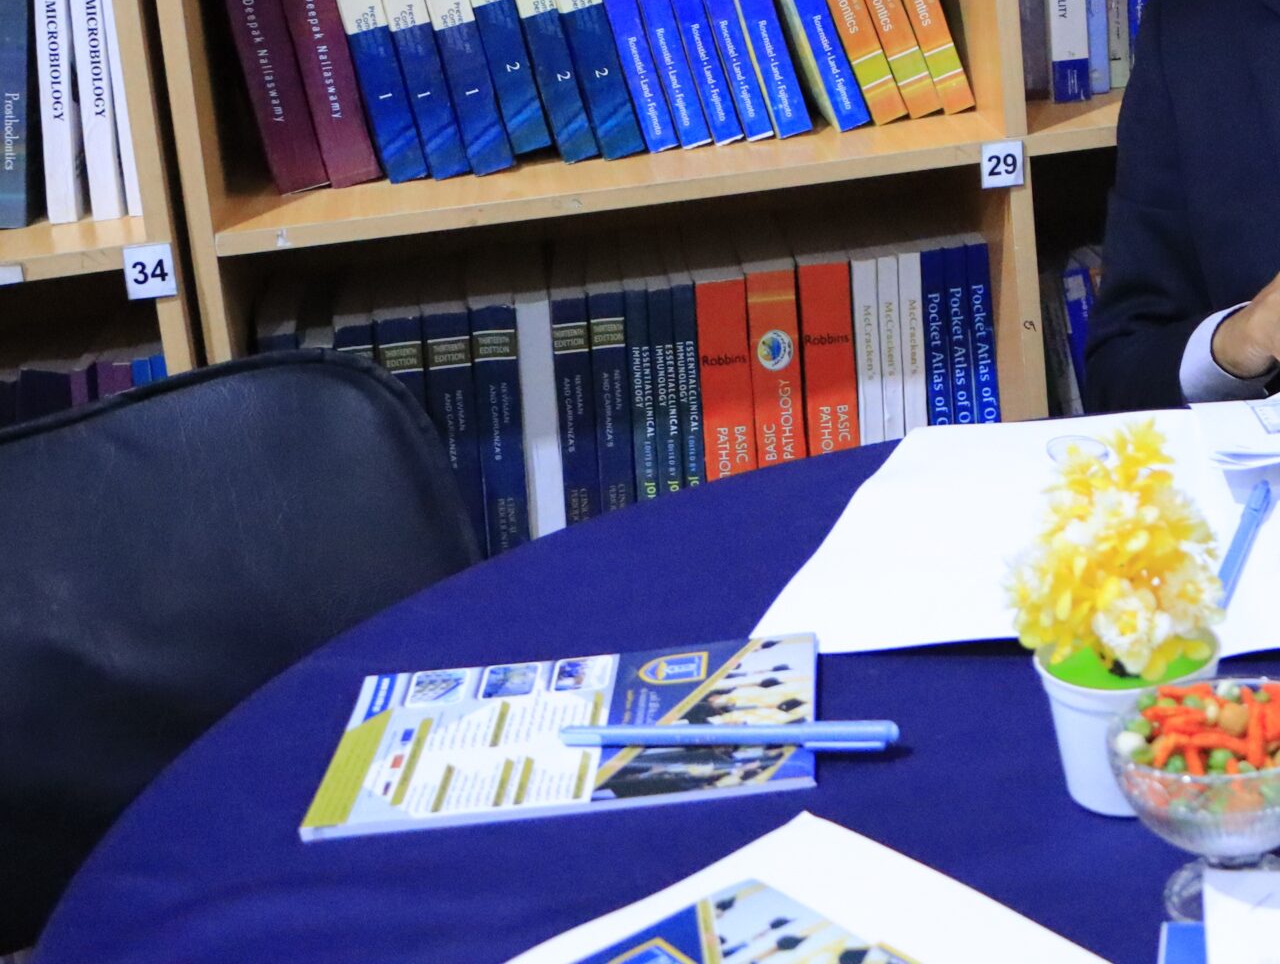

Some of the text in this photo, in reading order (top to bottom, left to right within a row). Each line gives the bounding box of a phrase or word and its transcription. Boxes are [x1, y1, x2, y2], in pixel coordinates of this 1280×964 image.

[45, 0, 65, 121] MICROBIOLOGY
[256, 49, 285, 124] Nallaswamy
[316, 45, 344, 120] Nallaswamy
[628, 36, 662, 136] Rosenstiel Land Fujimoto
[758, 20, 792, 118] Rosenstiel Land Fujimoto
[812, 14, 851, 111] Rosenstiel Land Fujimoto
[4, 92, 19, 171] Prosthodontics
[987, 153, 1017, 177] 29
[131, 258, 169, 284] 34
[702, 355, 747, 367] Robbins
[805, 334, 849, 346] Robbins
[928, 293, 945, 391] Pocket Atlas
[950, 287, 967, 385] Pocket Atlas
[971, 284, 991, 382] Pocket Atlas
[632, 347, 644, 408] IMMUNOLOGY
[655, 345, 667, 407] IMMUNOLOGY
[676, 342, 688, 403] IMMUNOLOGY
[735, 426, 748, 463] BASIC
[764, 424, 777, 461] BASIC
[779, 379, 795, 460] PATHOLOGY
[837, 405, 851, 441] BASIC
